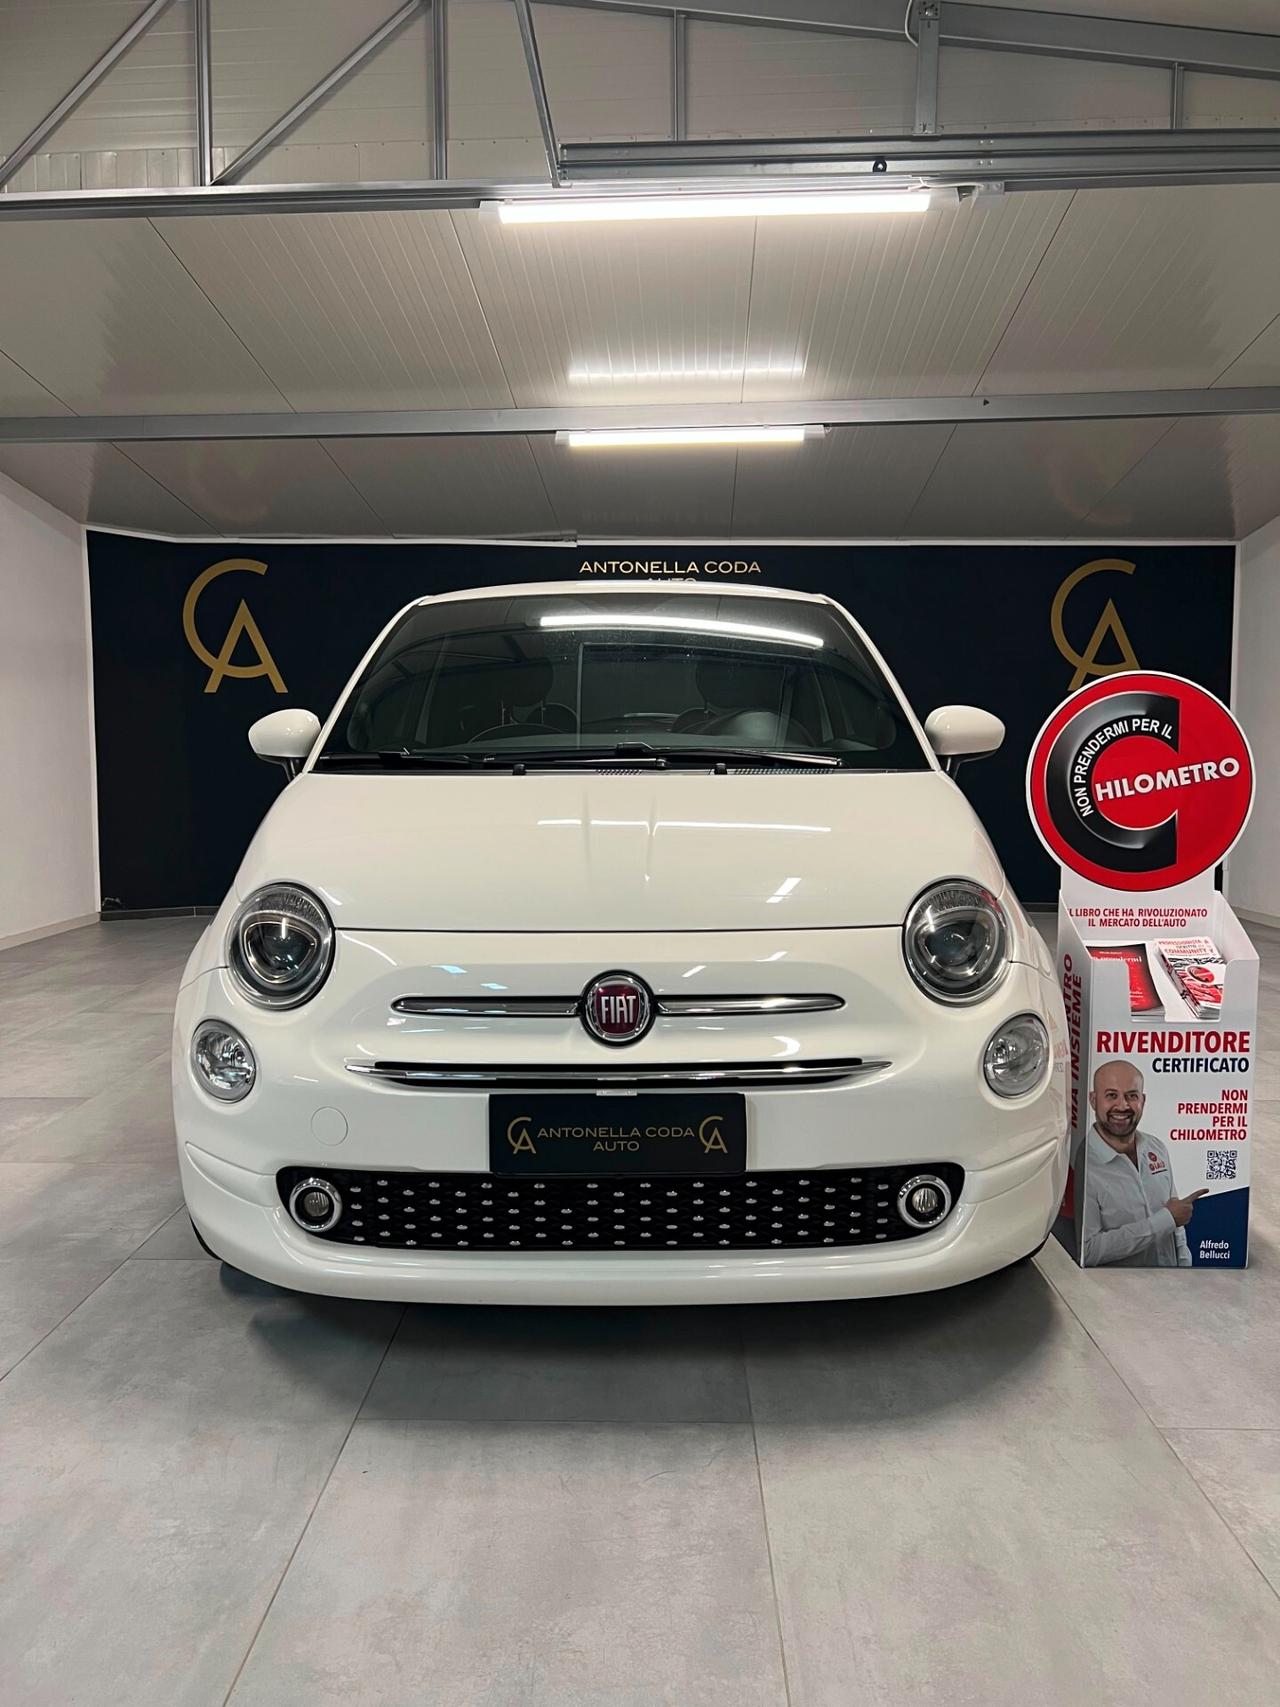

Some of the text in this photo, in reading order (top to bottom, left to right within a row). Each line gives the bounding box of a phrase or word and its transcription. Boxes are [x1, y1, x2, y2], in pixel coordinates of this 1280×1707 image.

[579, 560, 762, 574] ANTONELLA CODA
[1073, 718, 1174, 817] NON PRENDERMI PER IL
[1075, 908, 1101, 917] LIBRO
[1103, 908, 1120, 917] CHE
[1122, 908, 1134, 918] HA
[1138, 908, 1208, 918] RIVOLUZIONATO
[1088, 918, 1187, 928] IL MERCATO DELL'AUTO
[601, 995, 636, 1024] FIAT
[1071, 973, 1082, 1081] INSIEME
[1097, 1031, 1250, 1053] RIVENDITORE
[1152, 1057, 1249, 1073] CERTIFICATO
[1221, 1089, 1248, 1101] NON
[1178, 1103, 1247, 1115] PRENDERMI
[1212, 1116, 1247, 1127] PER IL
[537, 1127, 641, 1138] ANTONELLA
[645, 1127, 695, 1138] CODA
[1170, 1129, 1246, 1141] CHILOMETRO
[593, 1141, 640, 1151] AUTO
[1200, 1240, 1229, 1249] Alfredo
[1200, 1250, 1230, 1259] Bellucci
